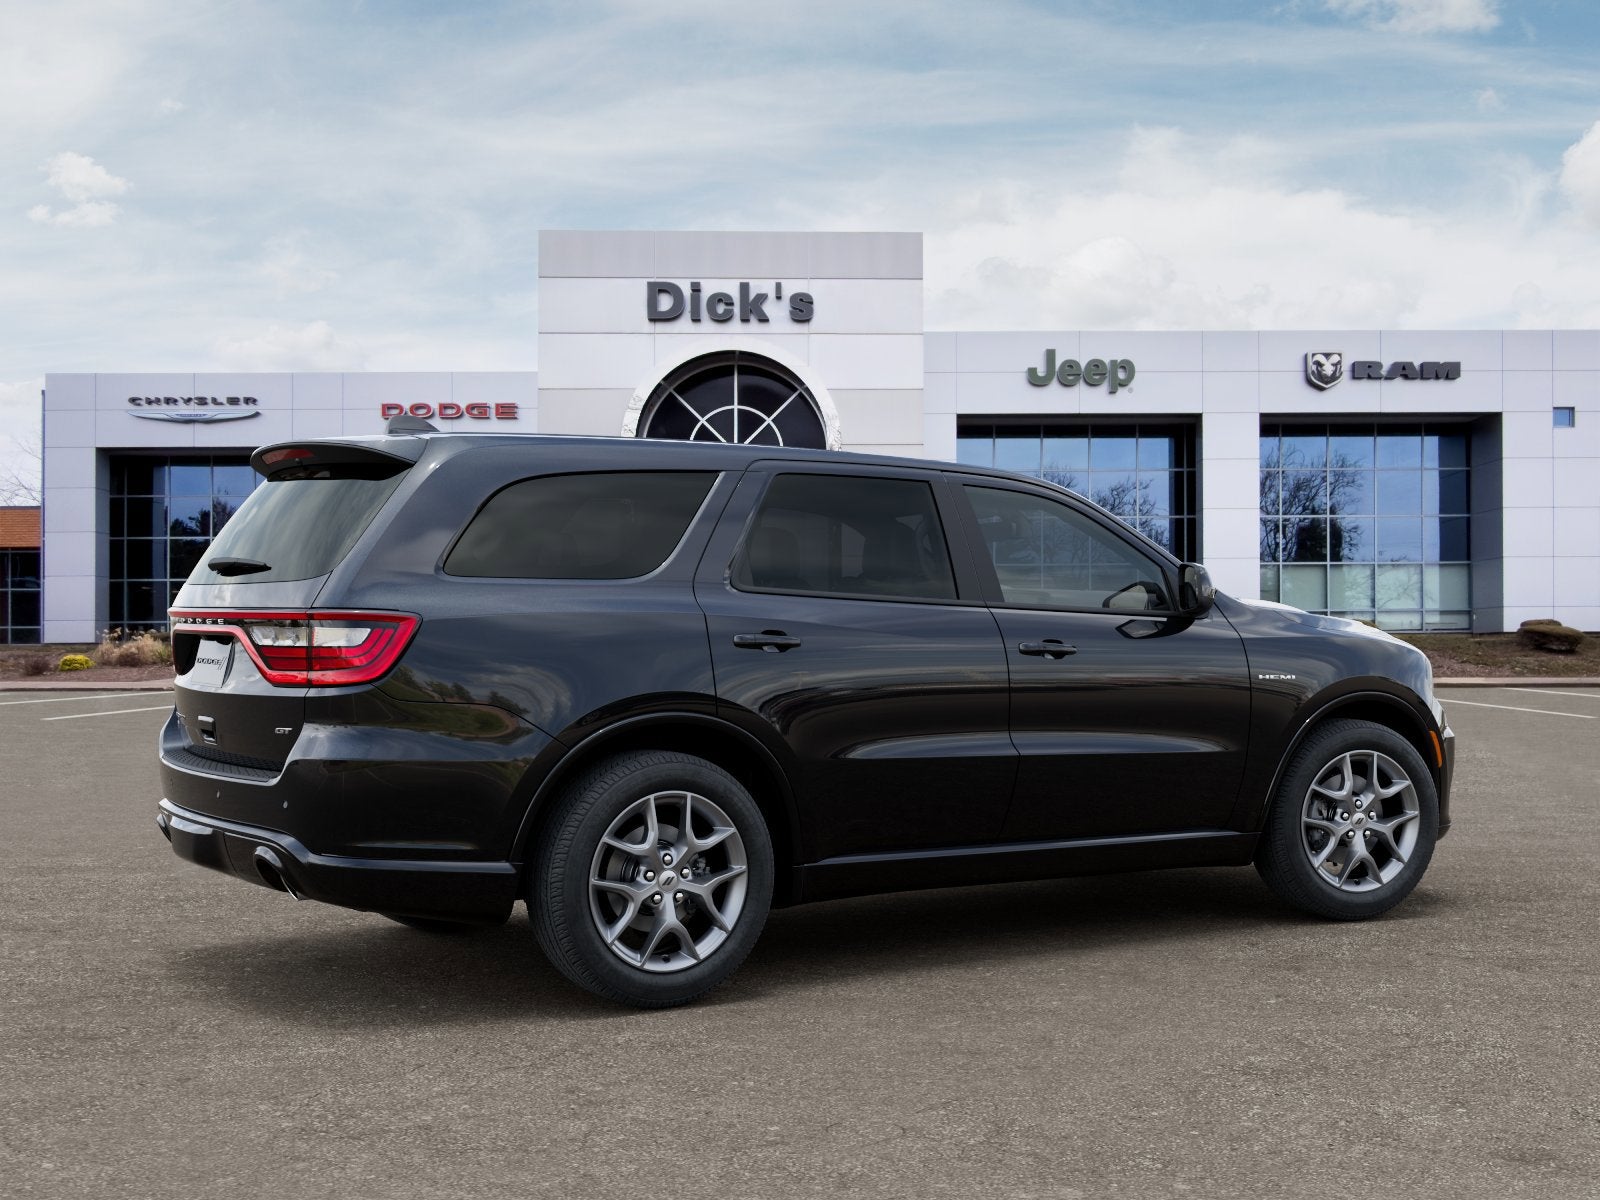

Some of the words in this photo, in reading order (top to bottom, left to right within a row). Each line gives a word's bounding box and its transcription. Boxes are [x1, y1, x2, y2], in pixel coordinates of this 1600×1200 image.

[647, 281, 814, 322] Dick's
[1027, 348, 1136, 394] Jeep
[1352, 360, 1461, 380] RAM
[127, 396, 258, 406] CHRYSLER
[381, 403, 519, 419] DODGE
[274, 727, 293, 735] GT
